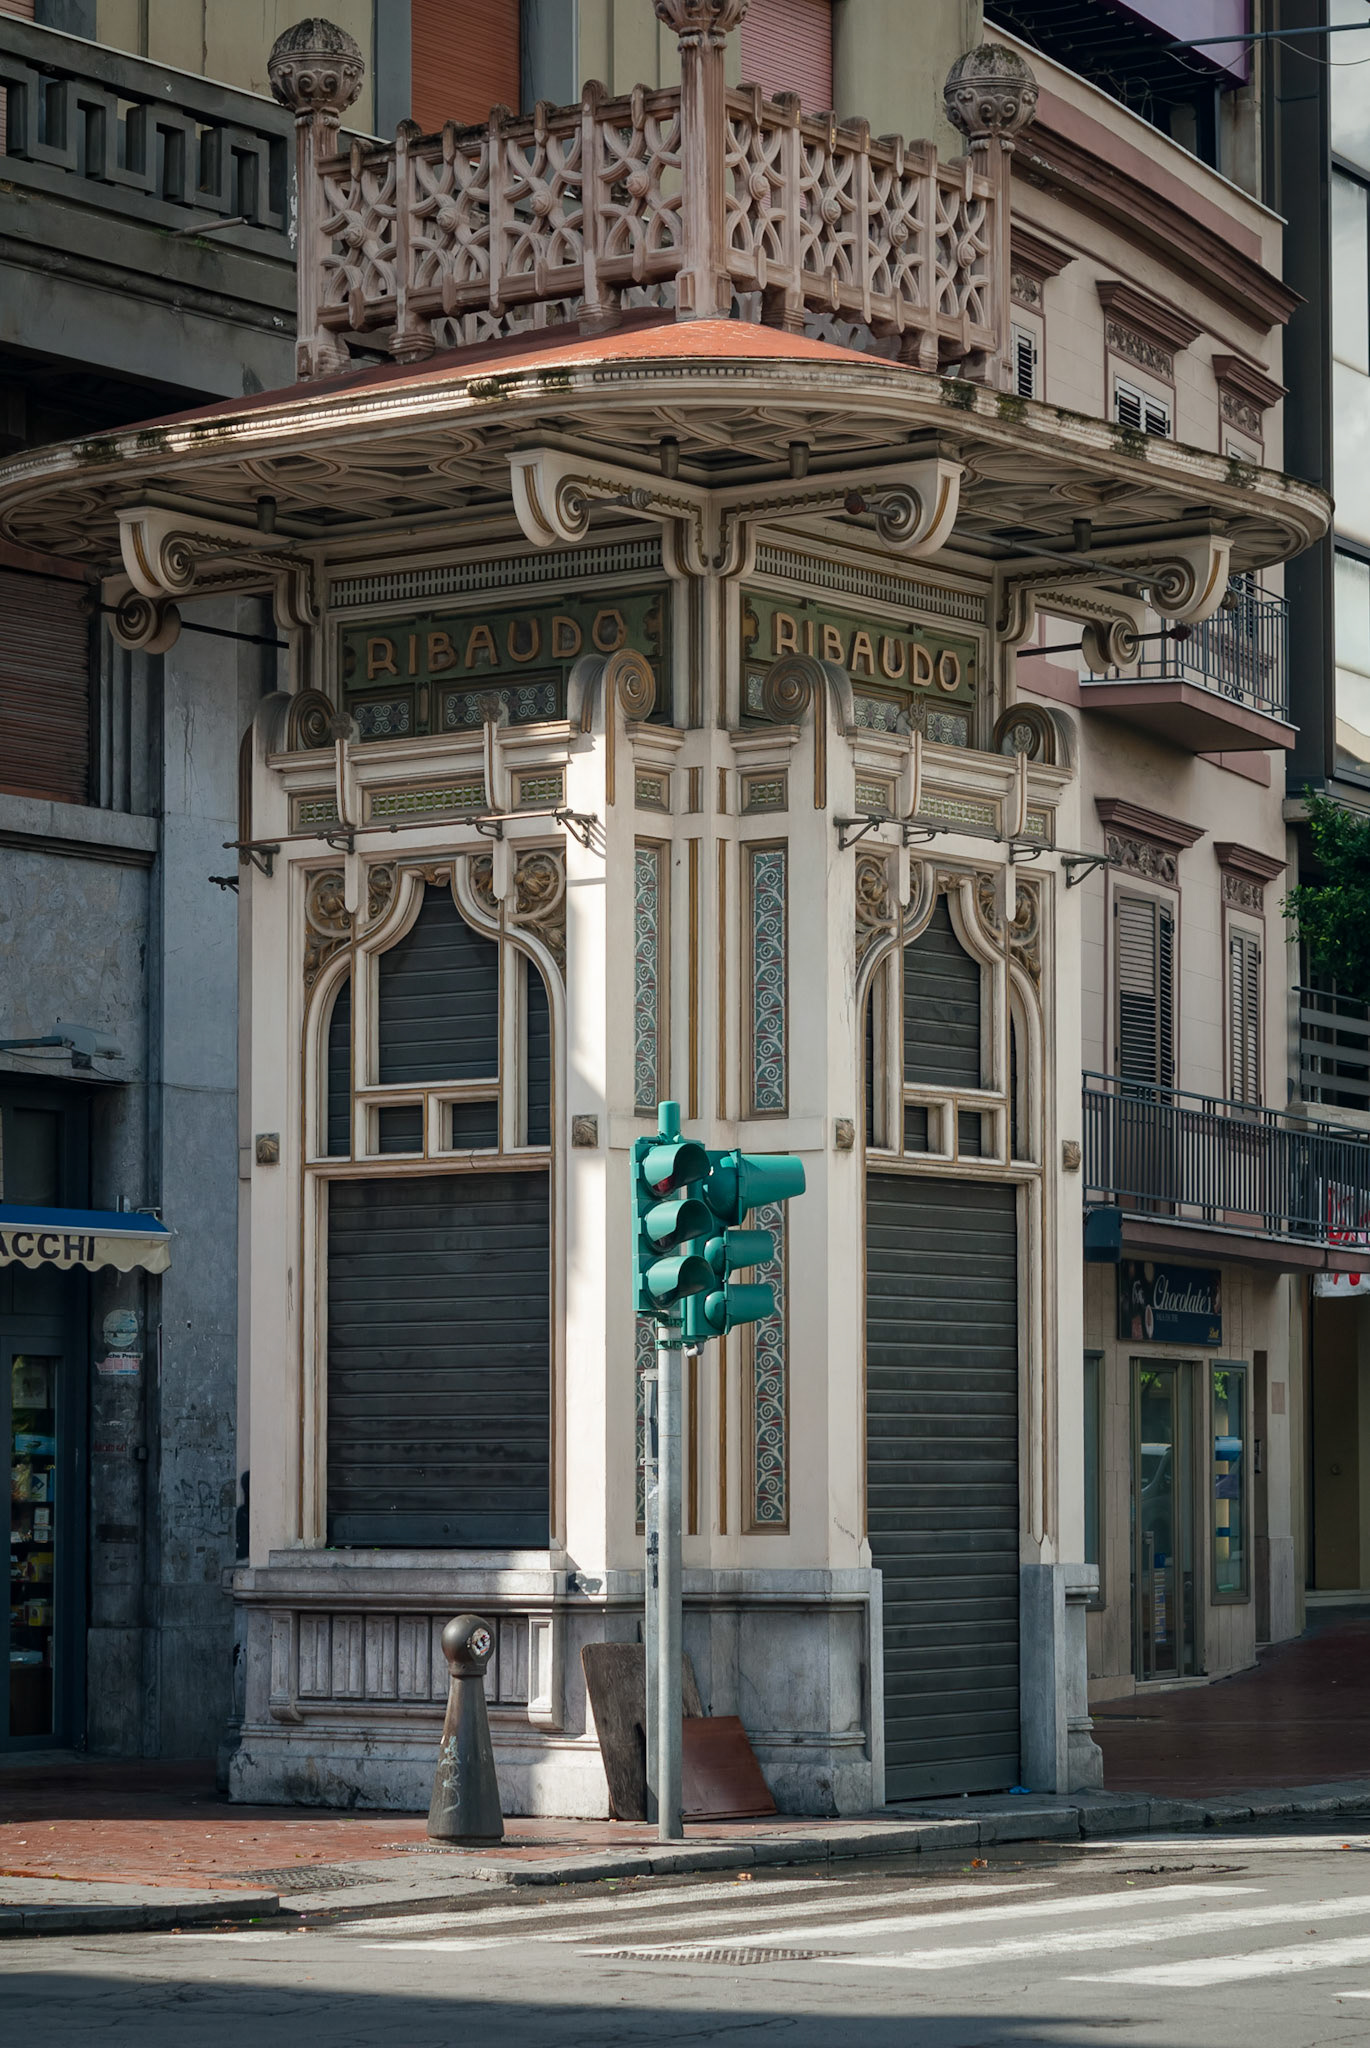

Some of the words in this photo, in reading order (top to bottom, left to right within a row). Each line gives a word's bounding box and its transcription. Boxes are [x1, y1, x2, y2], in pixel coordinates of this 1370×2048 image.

[367, 609, 627, 680] RIBAUDO
[772, 611, 961, 692] RIBAUDO
[1153, 1274, 1212, 1314] Chocolate's
